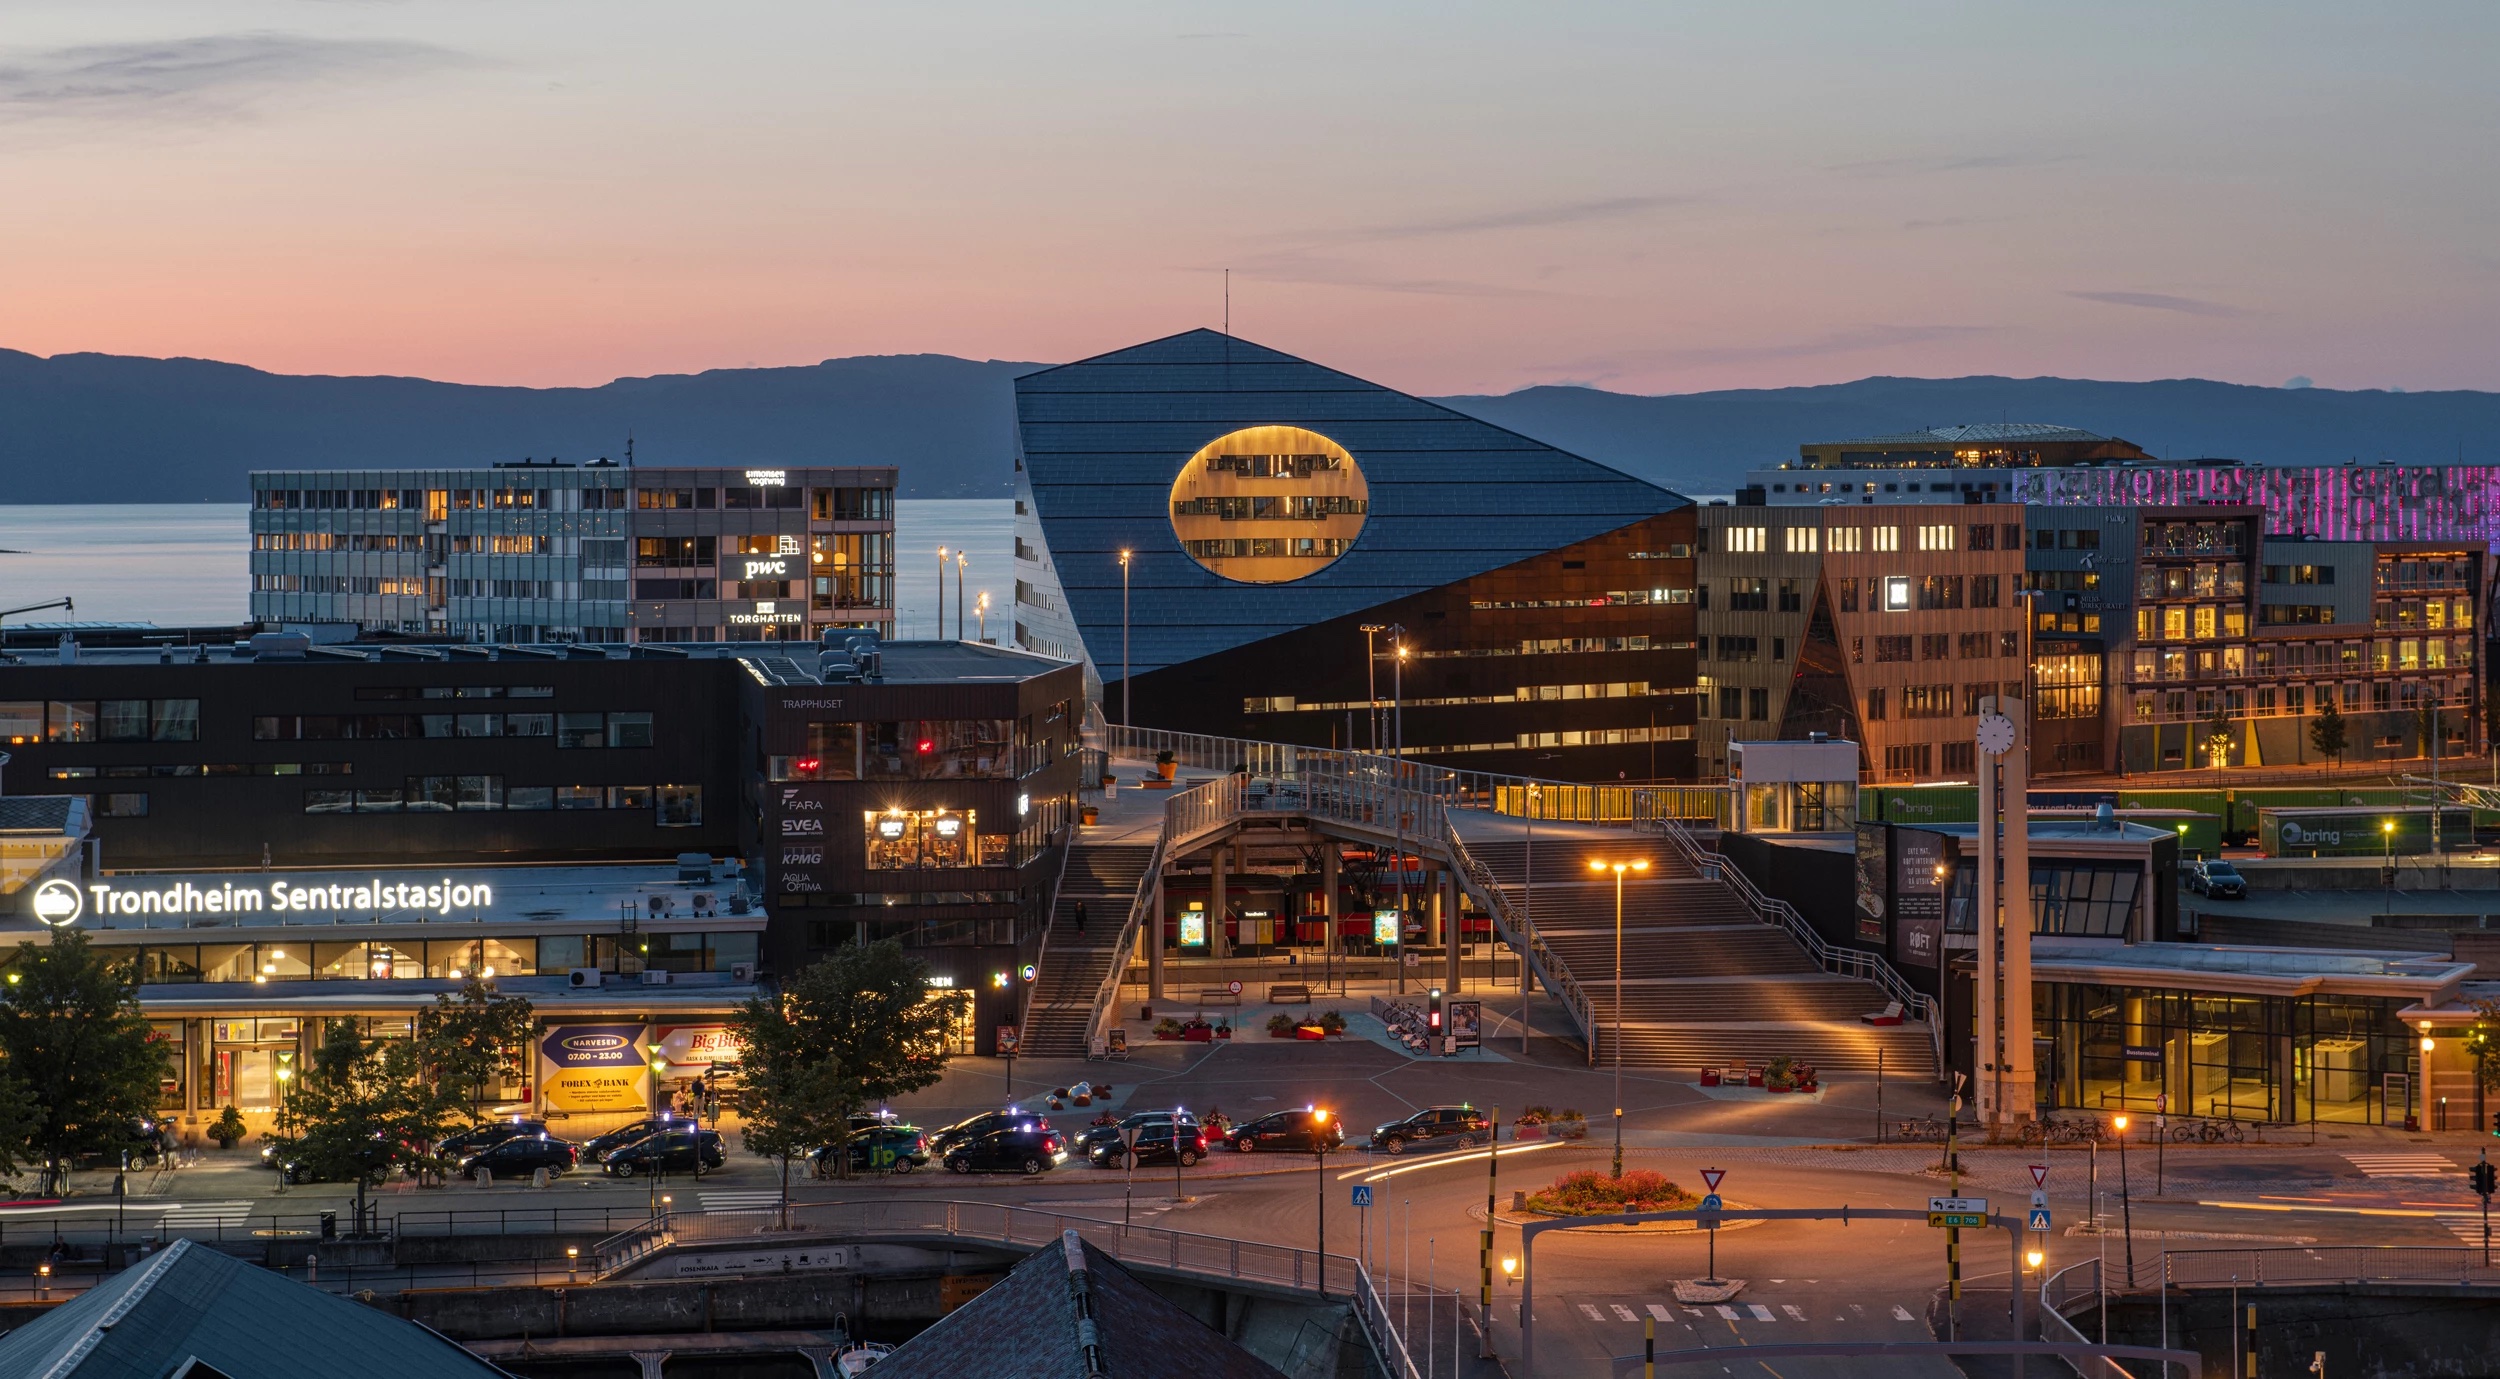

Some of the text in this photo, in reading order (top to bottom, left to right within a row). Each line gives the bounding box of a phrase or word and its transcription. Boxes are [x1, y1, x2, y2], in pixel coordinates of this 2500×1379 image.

[746, 470, 786, 478] simonsen
[745, 560, 786, 579] pwc
[730, 613, 801, 624] TORGHATTEN
[782, 699, 843, 709] TRAPPHUSET
[789, 800, 823, 810] FARA
[1905, 803, 1933, 816] bring
[781, 818, 823, 831] SVEA
[2302, 828, 2340, 845] bring
[782, 854, 822, 864] KPMG
[786, 882, 822, 892] OPTIMA
[90, 879, 492, 915] Trondheim Sentralstasjon
[1909, 931, 1931, 950] RØFT
[573, 1039, 618, 1047] NARVESEN
[690, 1034, 715, 1053] Big
[567, 1052, 591, 1061] 07.00
[599, 1052, 623, 1060] 23.00
[2126, 1049, 2160, 1057] Bussterminal
[561, 1078, 630, 1088] FOREX BANK
[870, 1145, 896, 1167] jp
[680, 1265, 719, 1273] FOSENKAIA
